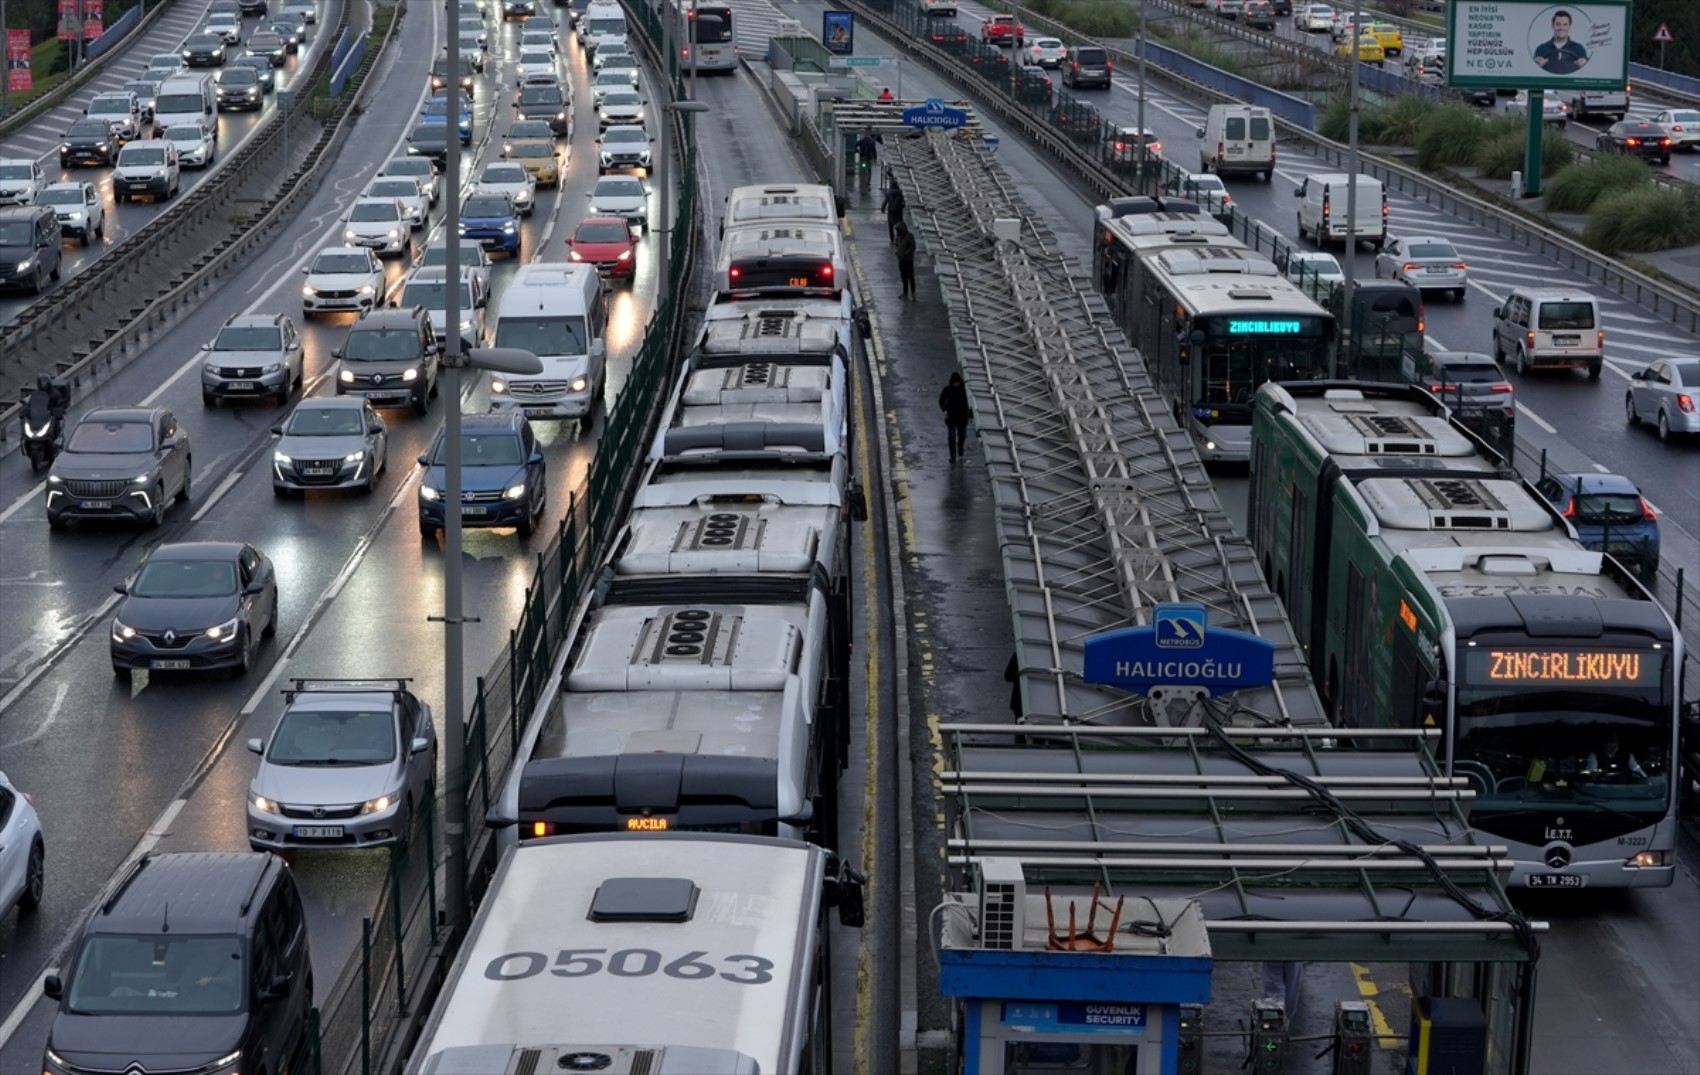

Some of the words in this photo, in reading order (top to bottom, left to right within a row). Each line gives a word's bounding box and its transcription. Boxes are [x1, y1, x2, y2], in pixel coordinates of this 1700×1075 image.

[1469, 5, 1479, 13] EN
[1468, 22, 1493, 30] KASKO
[1467, 38, 1503, 47] YÜZÜNÜZ
[1483, 47, 1514, 56] GÜLSÜN
[1466, 58, 1513, 69] NEOVA
[1115, 658, 1242, 679] HALICIOĞLU
[1489, 651, 1639, 680] ZİNCİRLİKUYU
[1616, 836, 1647, 846] M-3223
[1531, 875, 1542, 886] 34
[1546, 875, 1557, 886] TN
[1559, 875, 1580, 886] 2953
[1085, 1014, 1141, 1025] SECURITY
